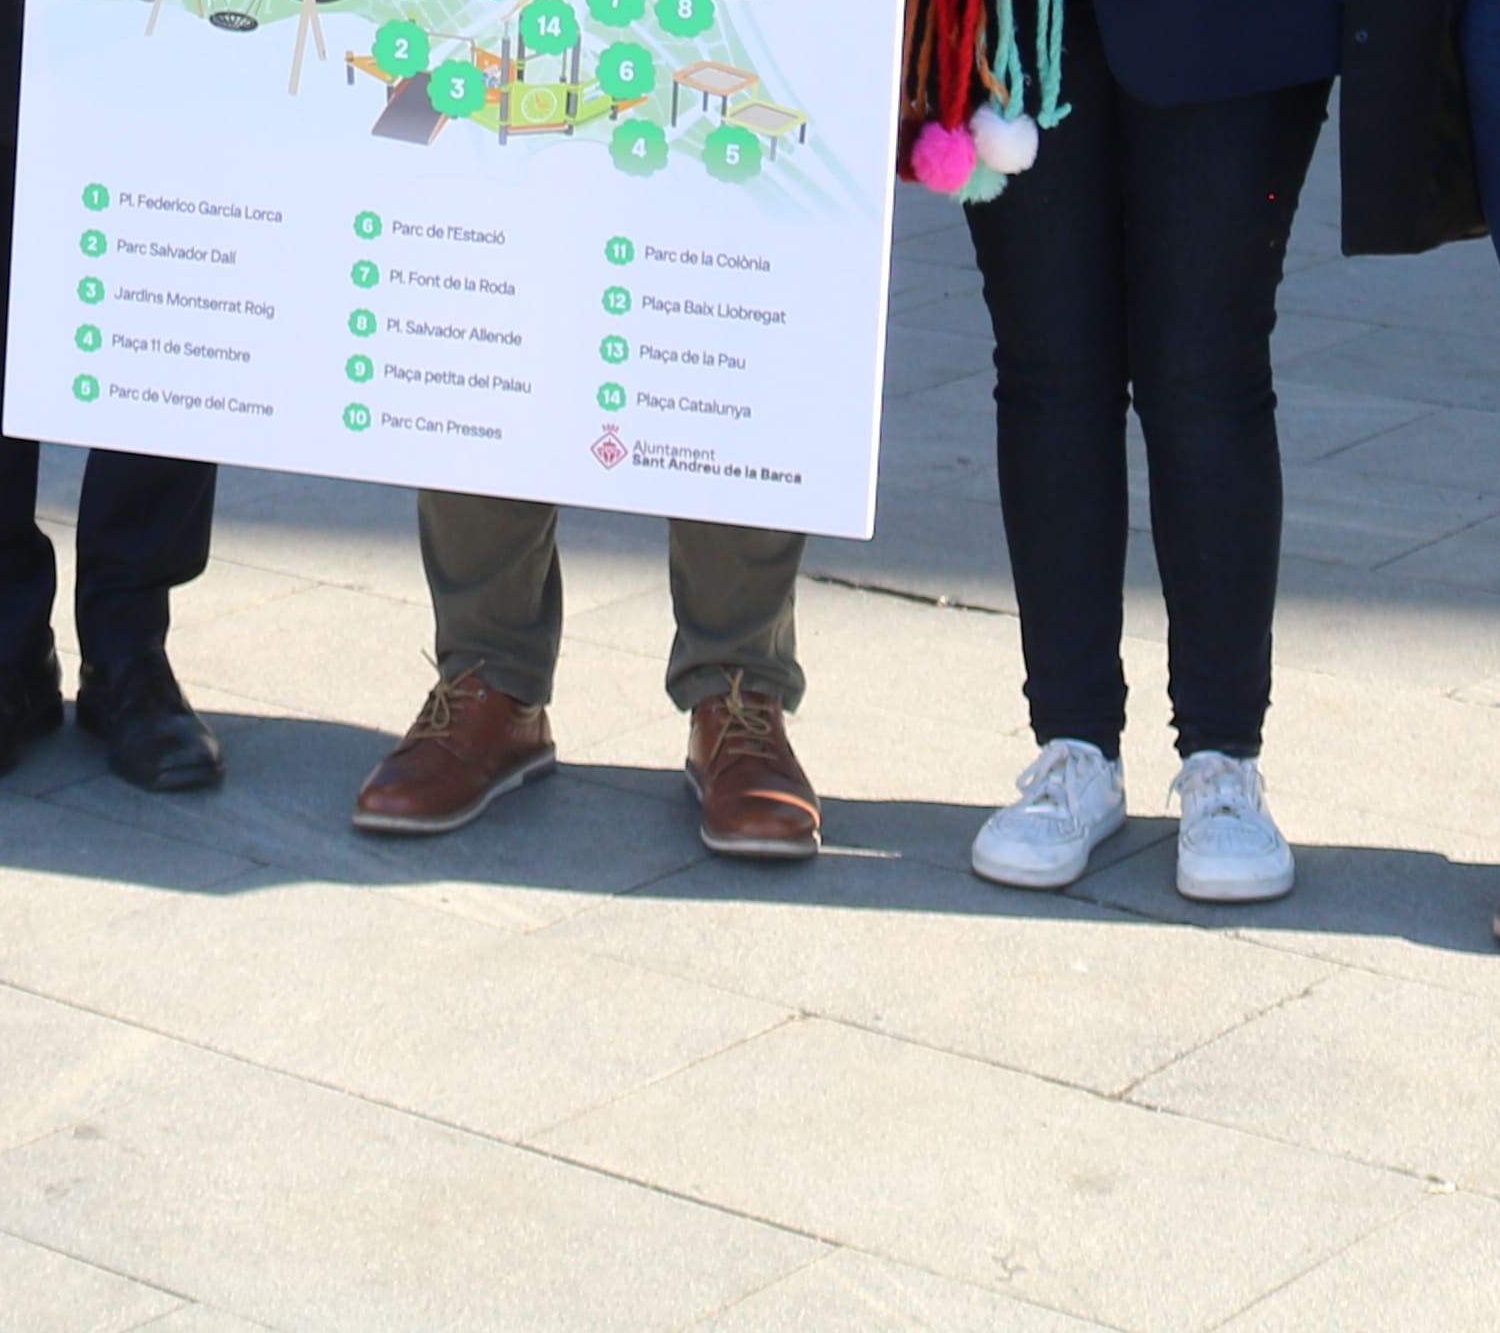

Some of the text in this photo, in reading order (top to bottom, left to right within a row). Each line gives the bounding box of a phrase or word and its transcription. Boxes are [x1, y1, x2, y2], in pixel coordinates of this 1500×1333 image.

[537, 16, 561, 37] 14
[395, 38, 409, 59] 2
[619, 60, 634, 82] 6
[450, 78, 465, 99] 3
[632, 137, 647, 158] 4
[725, 143, 739, 165] 5
[92, 190, 283, 223] 1 Pl. Federico García Lorca
[362, 218, 505, 245] 6 Parc de l'Estació
[87, 236, 237, 264] 2 Parc Salvador Dalí
[612, 243, 771, 271] 11 Parc de la Colònia
[360, 267, 515, 295] 7 Pl. Font de la Roda
[86, 283, 275, 320] 3 Jardins Montserrat Roig
[608, 293, 786, 326] 12 Plaça Baix Llobregat
[357, 316, 522, 345] 8 Pl. Salvador Allende
[83, 331, 251, 363] 4 Plaça 11 de Setembre
[606, 342, 746, 370] 13 Plaça de la Pau
[355, 362, 531, 393] 9 Plaça petita del Palau
[81, 382, 274, 416] 5 Parc de Verge del Carme
[602, 390, 751, 420] 14 Plaça Catalunya
[349, 410, 502, 439] 10 Parc Can Presses
[633, 441, 715, 462] Ajuntament
[633, 454, 802, 485] Sant Andreu de la Barca
